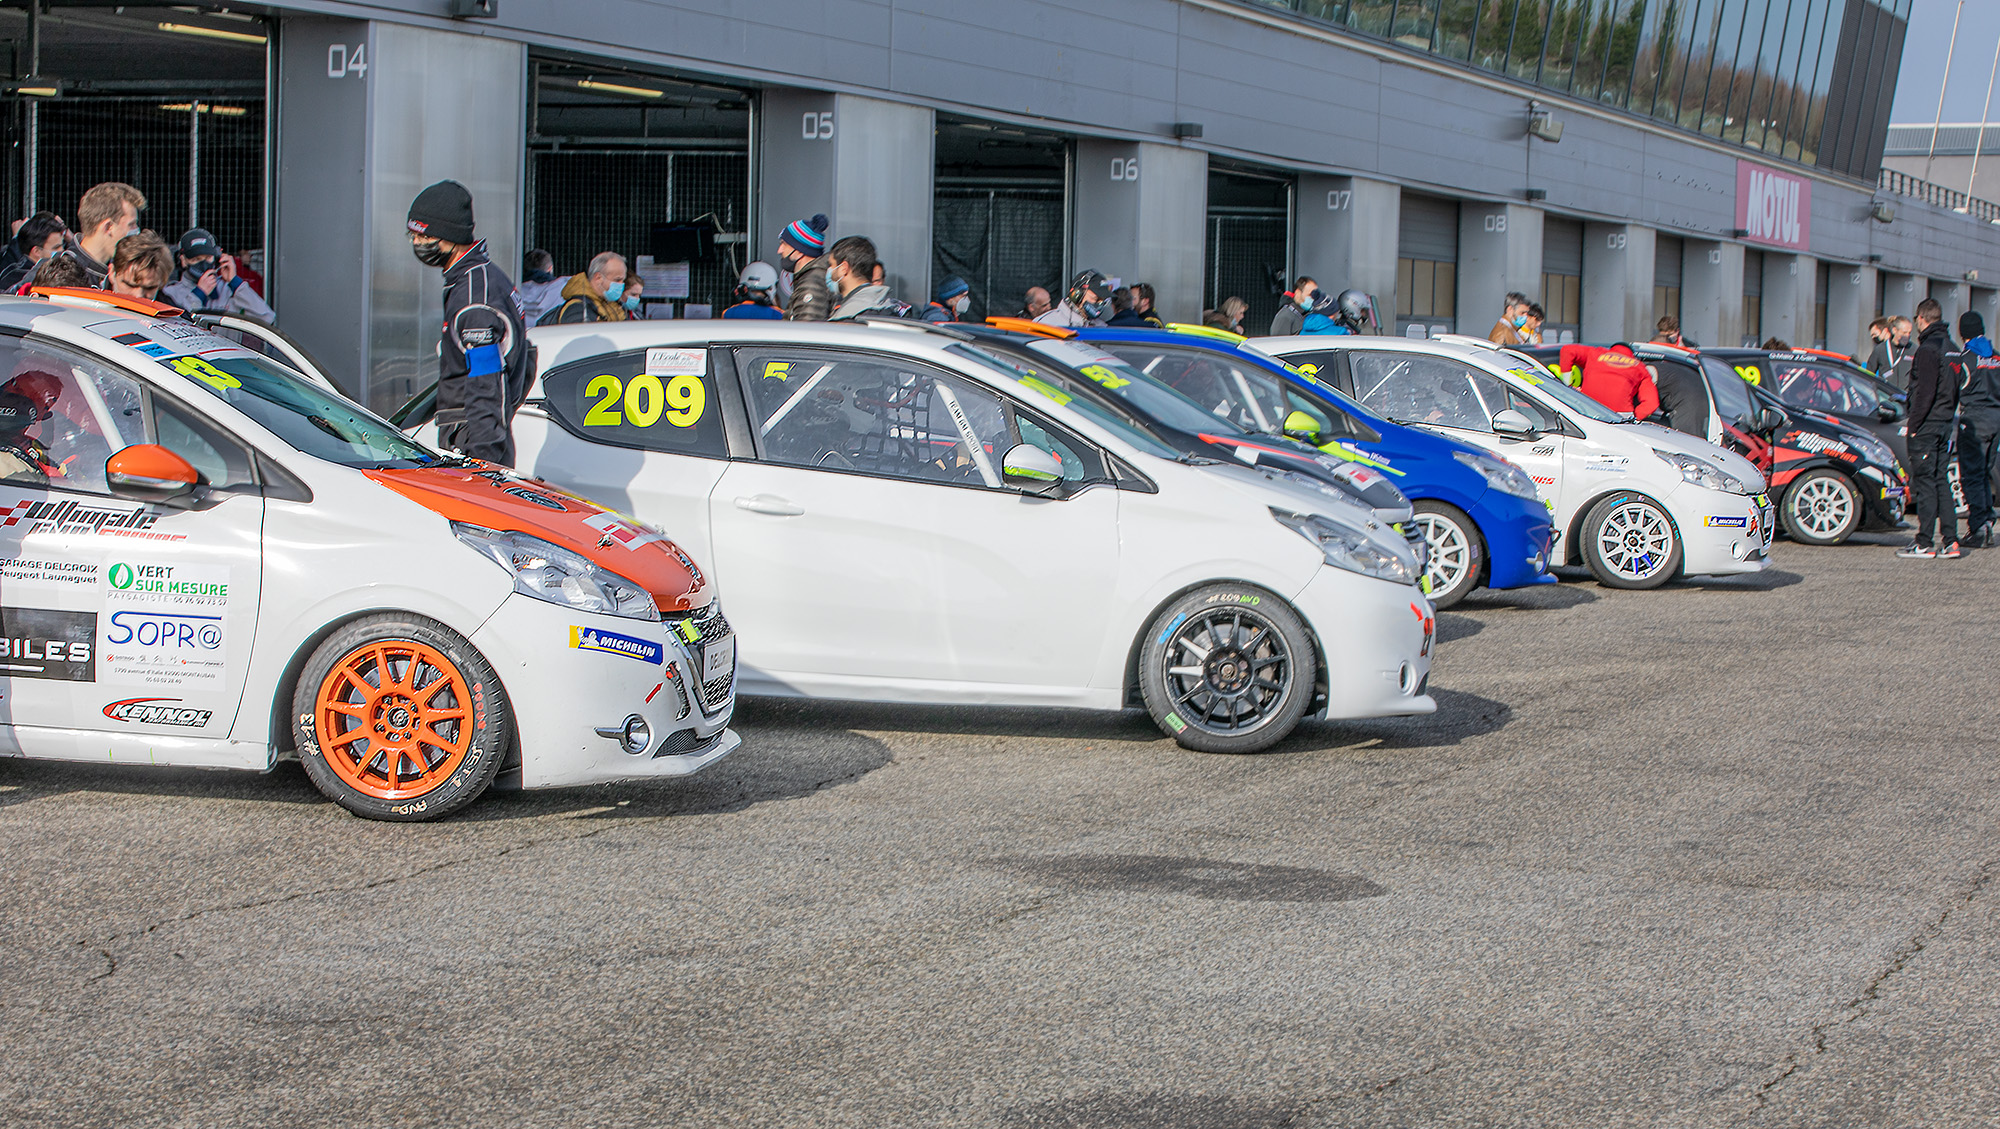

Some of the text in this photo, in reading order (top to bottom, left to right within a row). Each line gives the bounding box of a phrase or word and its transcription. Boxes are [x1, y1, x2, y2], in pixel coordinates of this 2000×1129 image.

[327, 43, 367, 79] 04
[802, 111, 834, 140] 05
[1110, 157, 1138, 182] 06
[1327, 190, 1350, 210] 07
[1746, 169, 1801, 244] MOTUL
[1484, 213, 1507, 232] 08
[1607, 232, 1626, 250] 09
[1707, 249, 1721, 264] 10
[583, 374, 706, 428] 209
[949, 400, 962, 419] TEAM
[0, 558, 98, 574] GARAGE DELCROIX
[137, 565, 175, 578] VERT
[42, 573, 98, 584] Launaguet
[135, 579, 228, 596] SUR MESURE
[107, 610, 223, 650] SOPR@
[600, 637, 655, 657] MICHELIN
[109, 704, 213, 722] KENNOL
